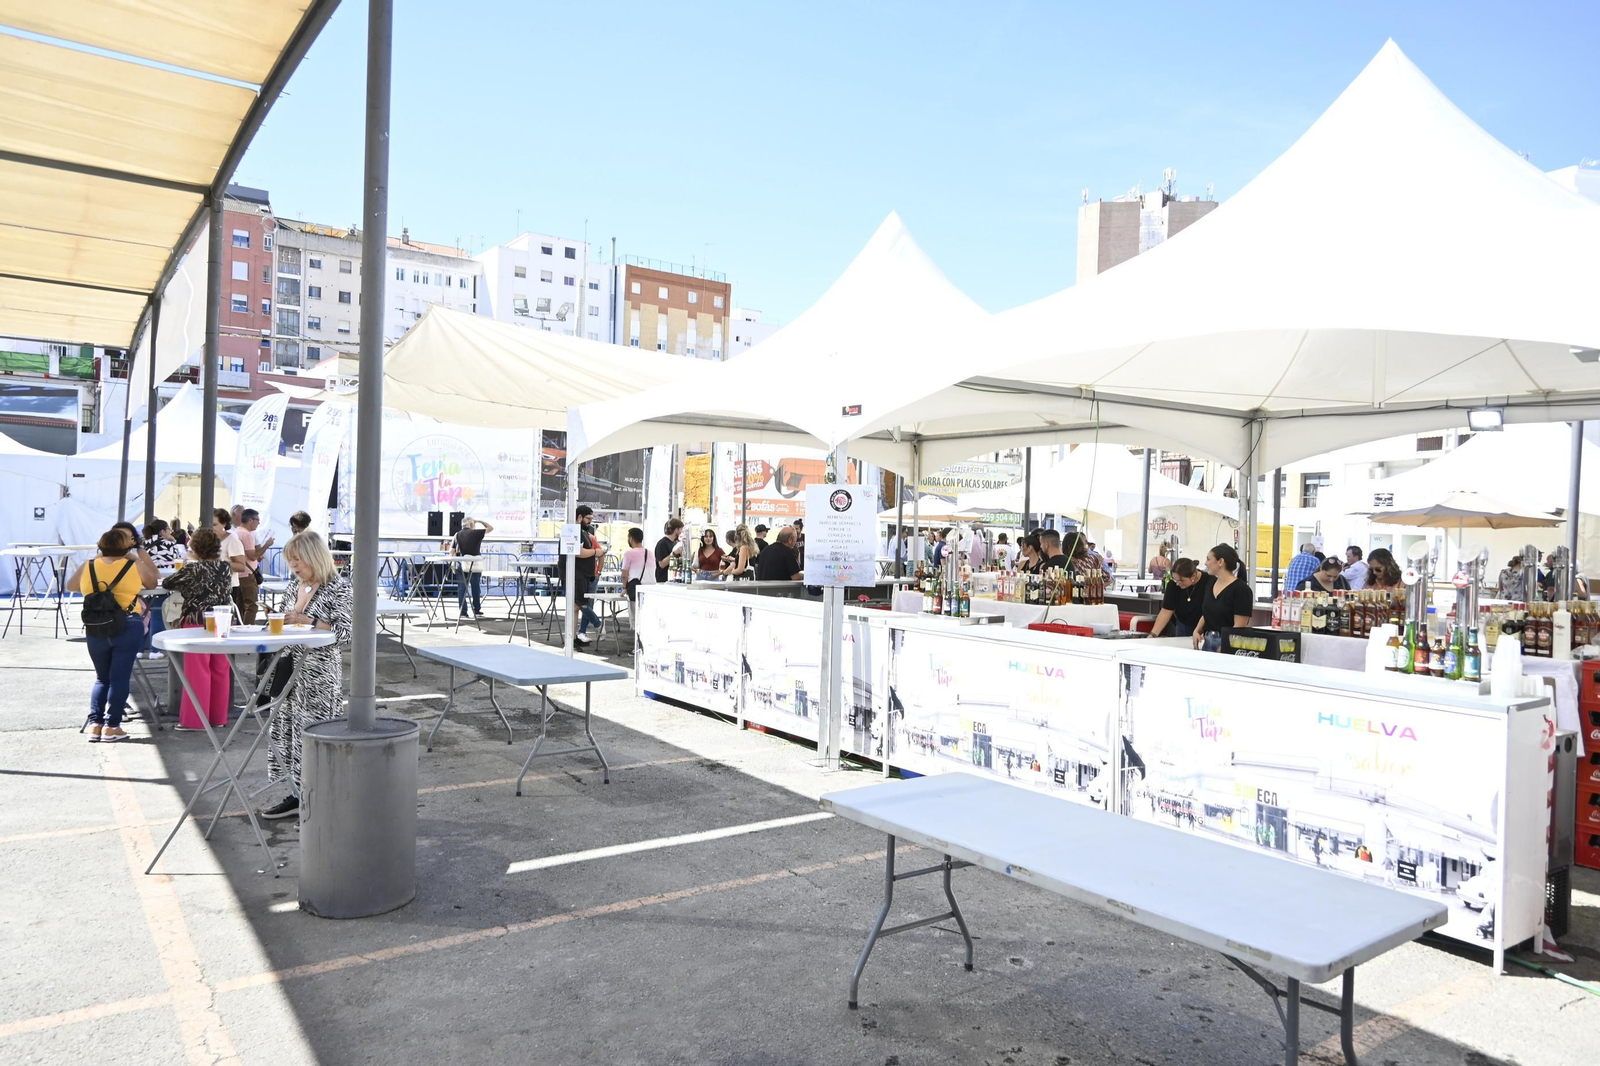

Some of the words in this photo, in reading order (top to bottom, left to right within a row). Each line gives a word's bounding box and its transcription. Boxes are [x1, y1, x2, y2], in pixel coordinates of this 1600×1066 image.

[406, 452, 462, 482] Feria
[423, 478, 474, 507] Tapa
[942, 477, 955, 487] CON
[957, 478, 981, 489] PLACAS
[982, 480, 1008, 489] SOLARES
[1008, 660, 1066, 680] HUELVA
[1318, 711, 1418, 742] HUELVA
